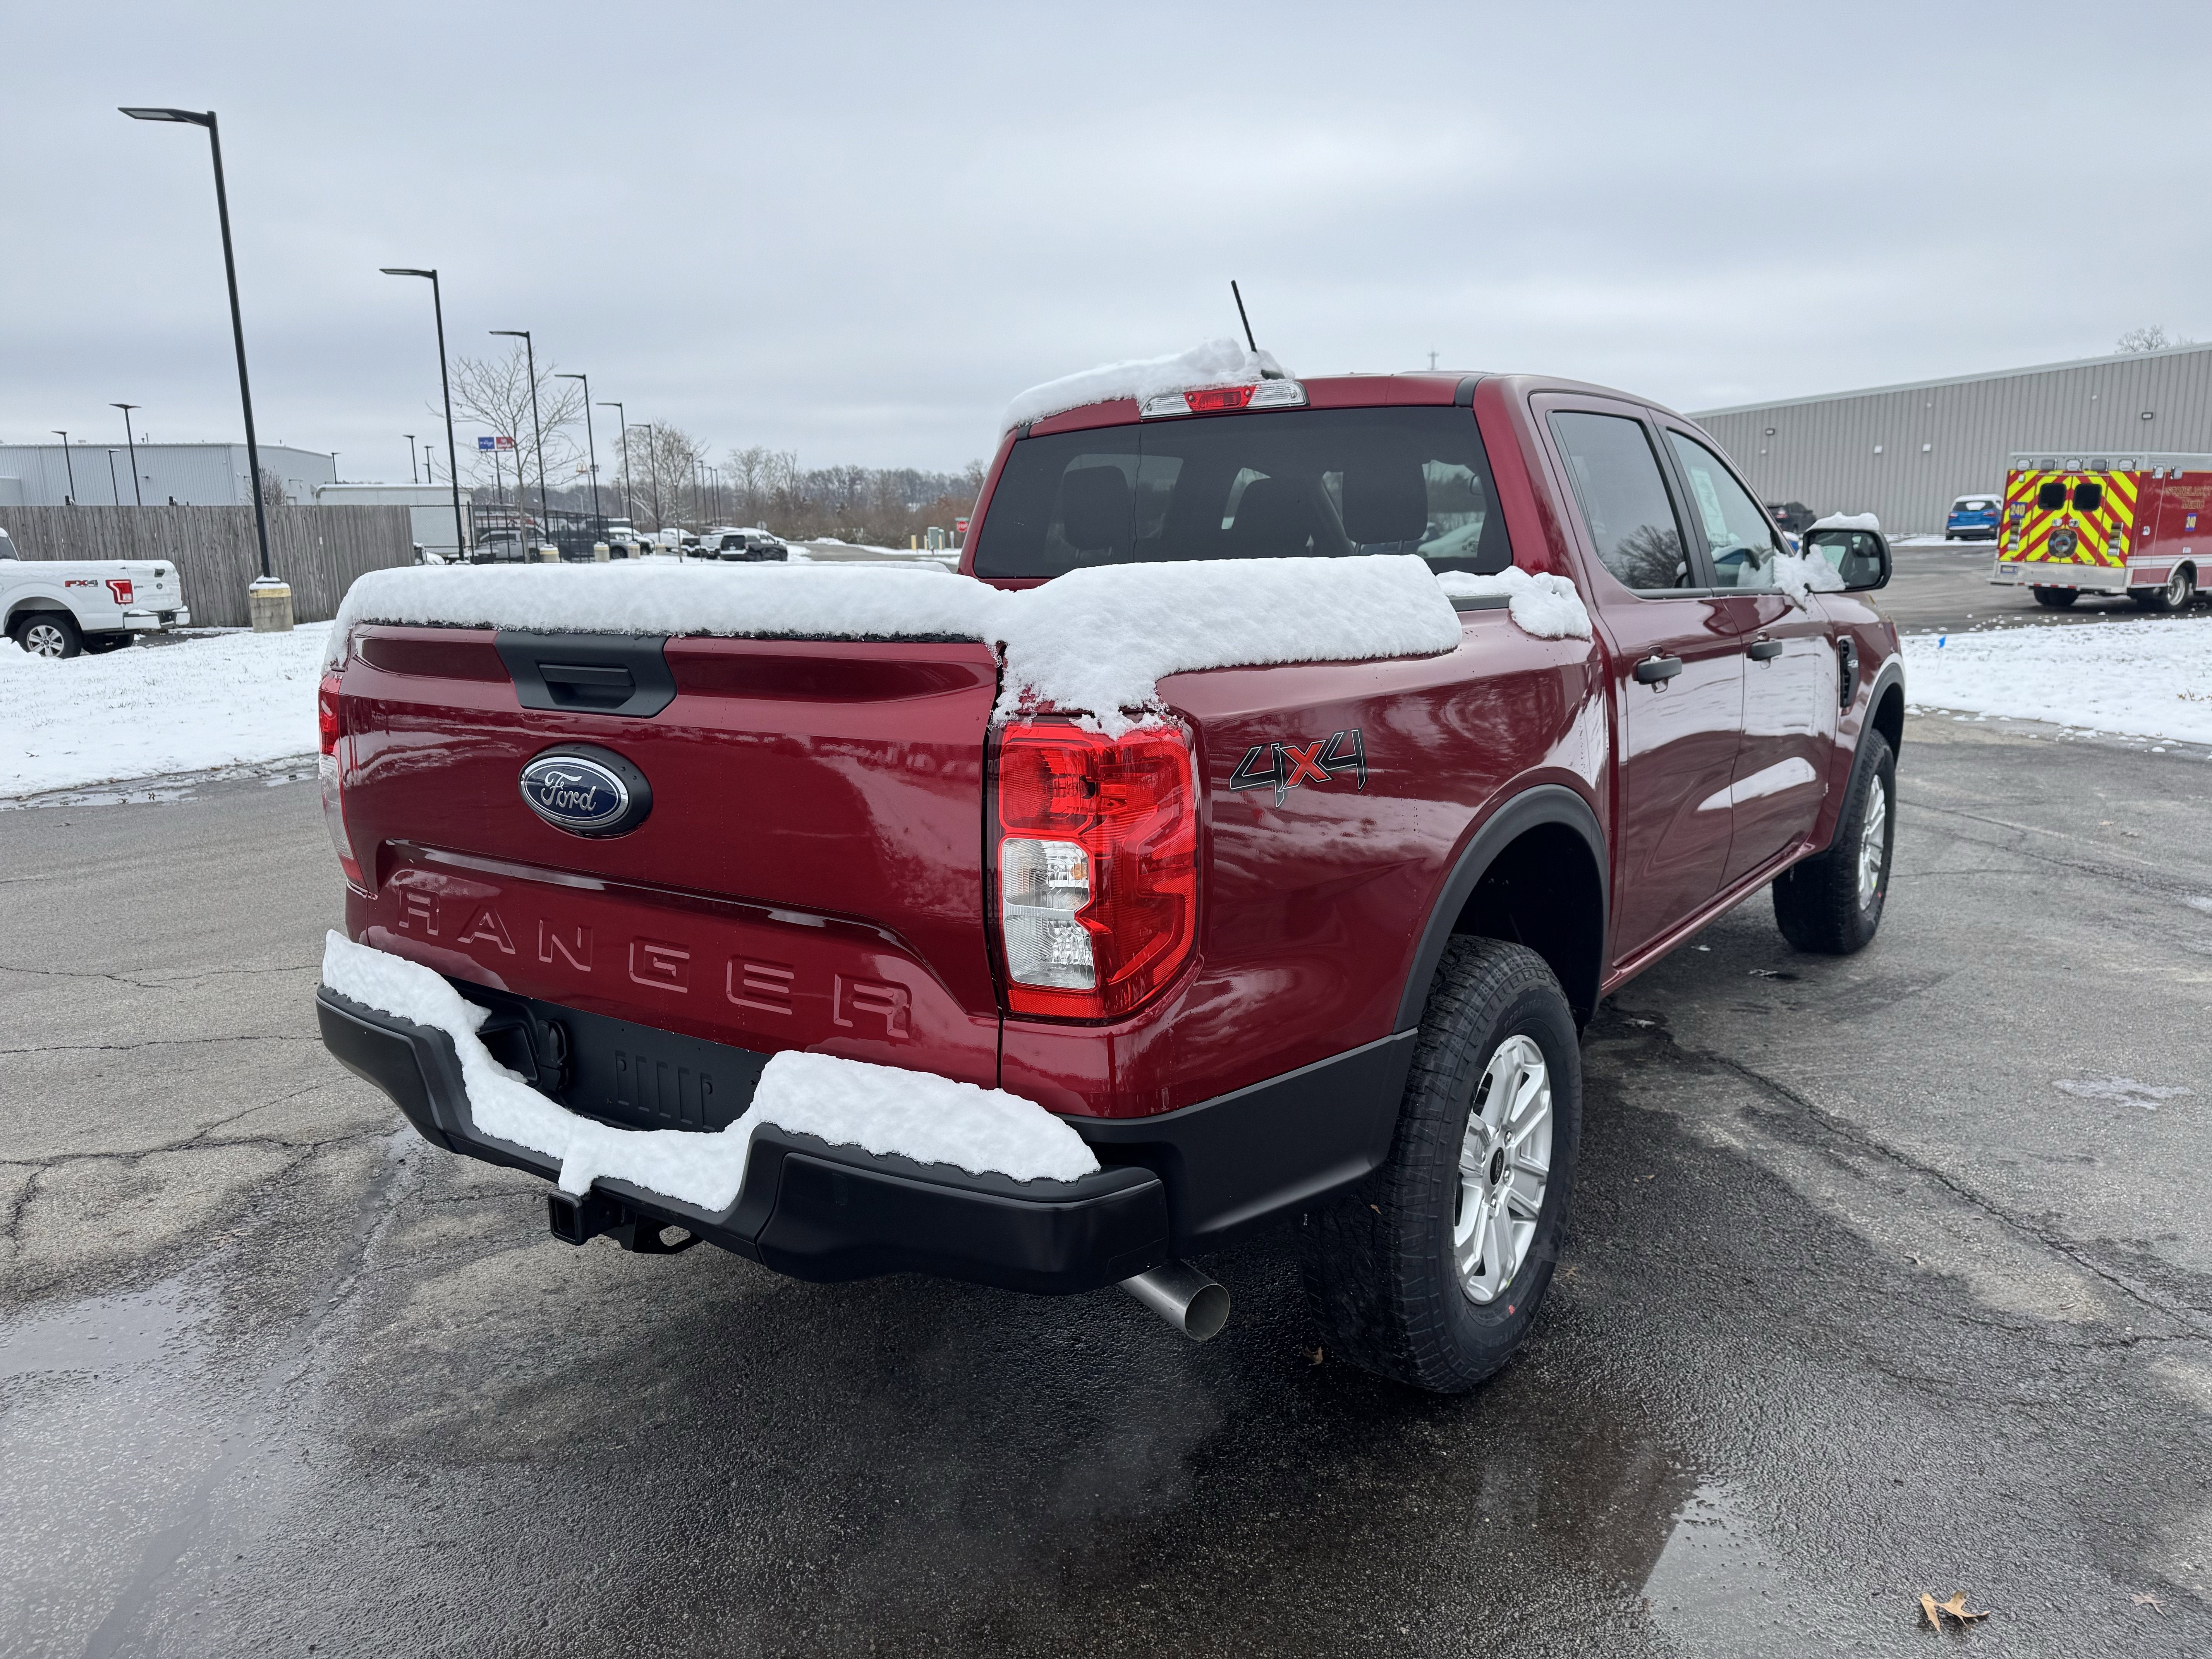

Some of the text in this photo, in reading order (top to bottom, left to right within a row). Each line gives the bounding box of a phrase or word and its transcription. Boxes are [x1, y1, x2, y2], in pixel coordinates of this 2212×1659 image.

[2010, 504, 2026, 516] 240
[541, 771, 598, 812] Ford
[398, 886, 914, 1040] RANGER
